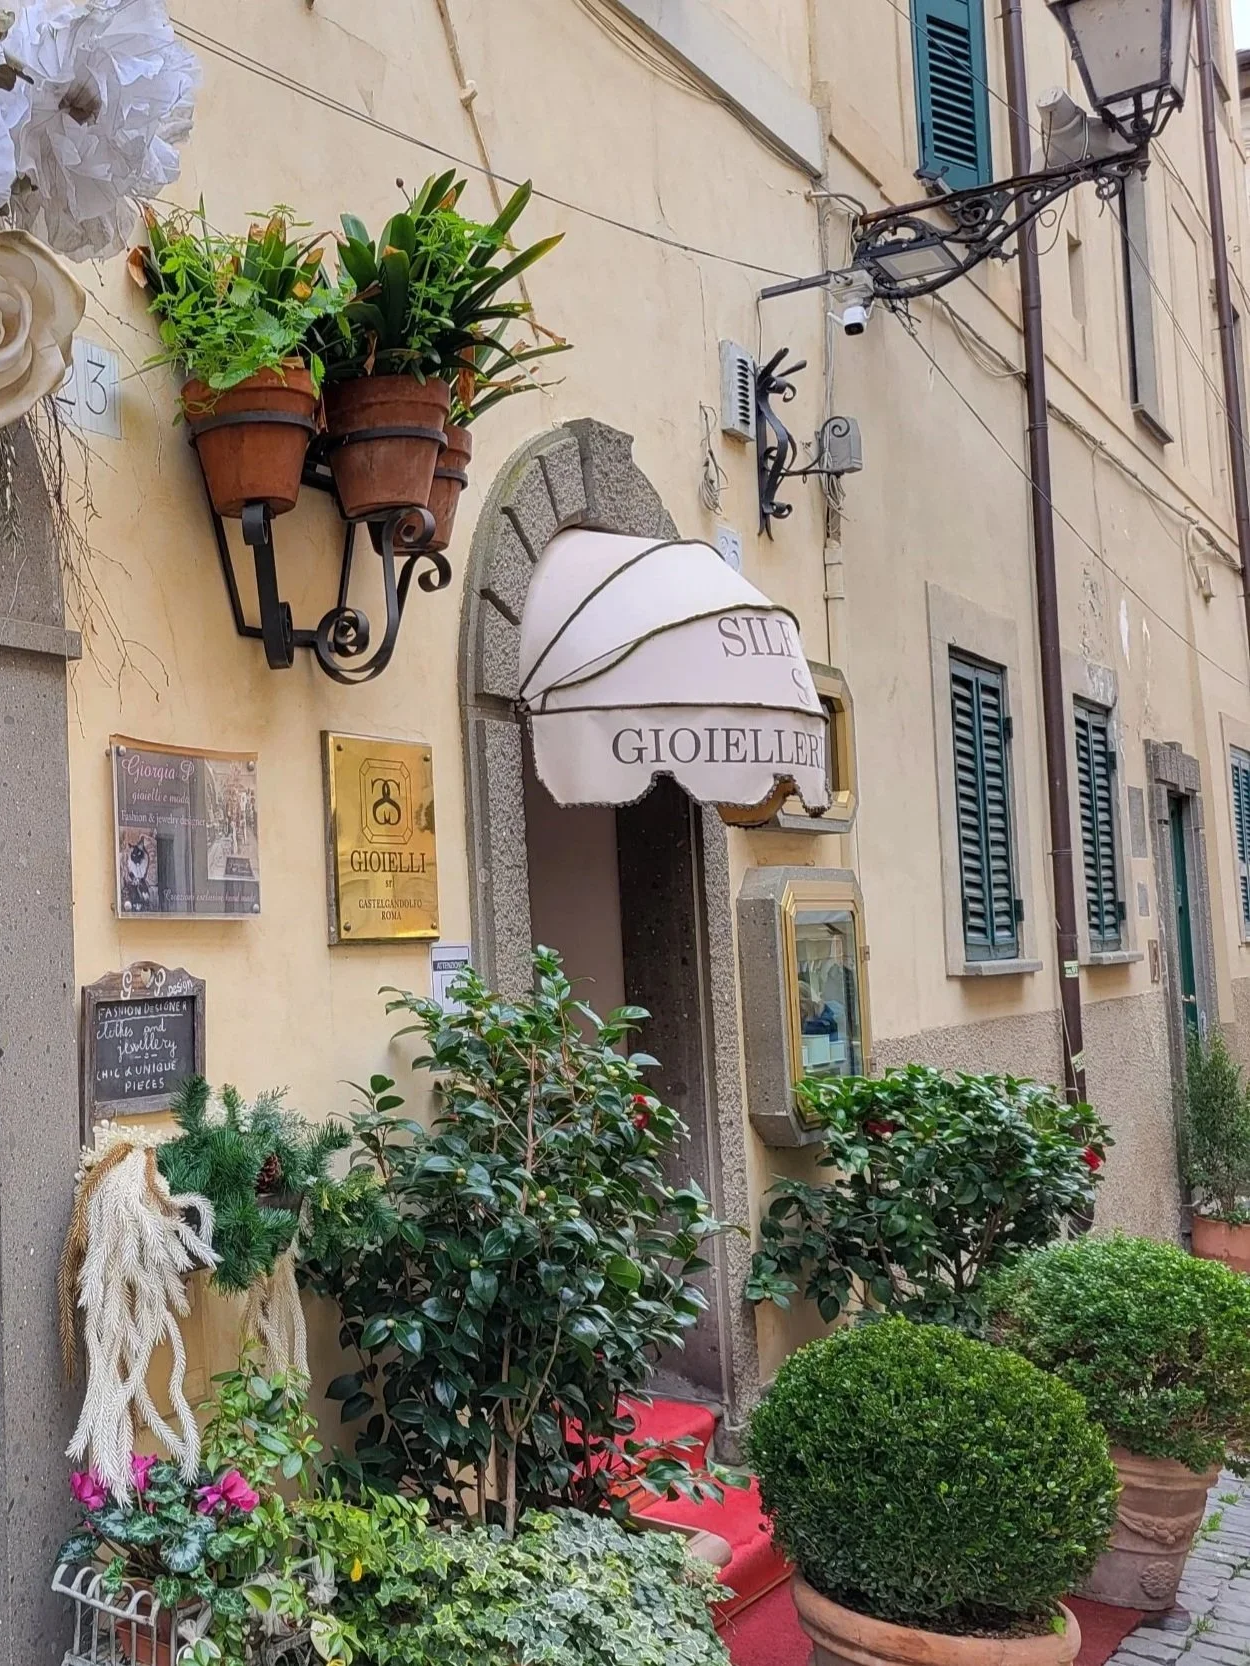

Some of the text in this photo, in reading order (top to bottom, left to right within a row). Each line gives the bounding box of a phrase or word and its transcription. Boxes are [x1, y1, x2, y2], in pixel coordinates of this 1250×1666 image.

[121, 754, 175, 786] Giorgia
[132, 787, 161, 805] gioielli
[121, 809, 206, 828] Fashion & jewelry designer
[350, 850, 427, 874] GIOIELLI
[385, 877, 395, 889] srl
[358, 898, 423, 909] CASTELGANDOLFO
[381, 910, 402, 921] ROMA
[98, 1004, 141, 1020] FASHION
[96, 1017, 166, 1040] clothes and
[96, 1067, 120, 1081] CHIC
[135, 1060, 177, 1076] UNIQUE
[125, 1077, 165, 1093] PIECES
